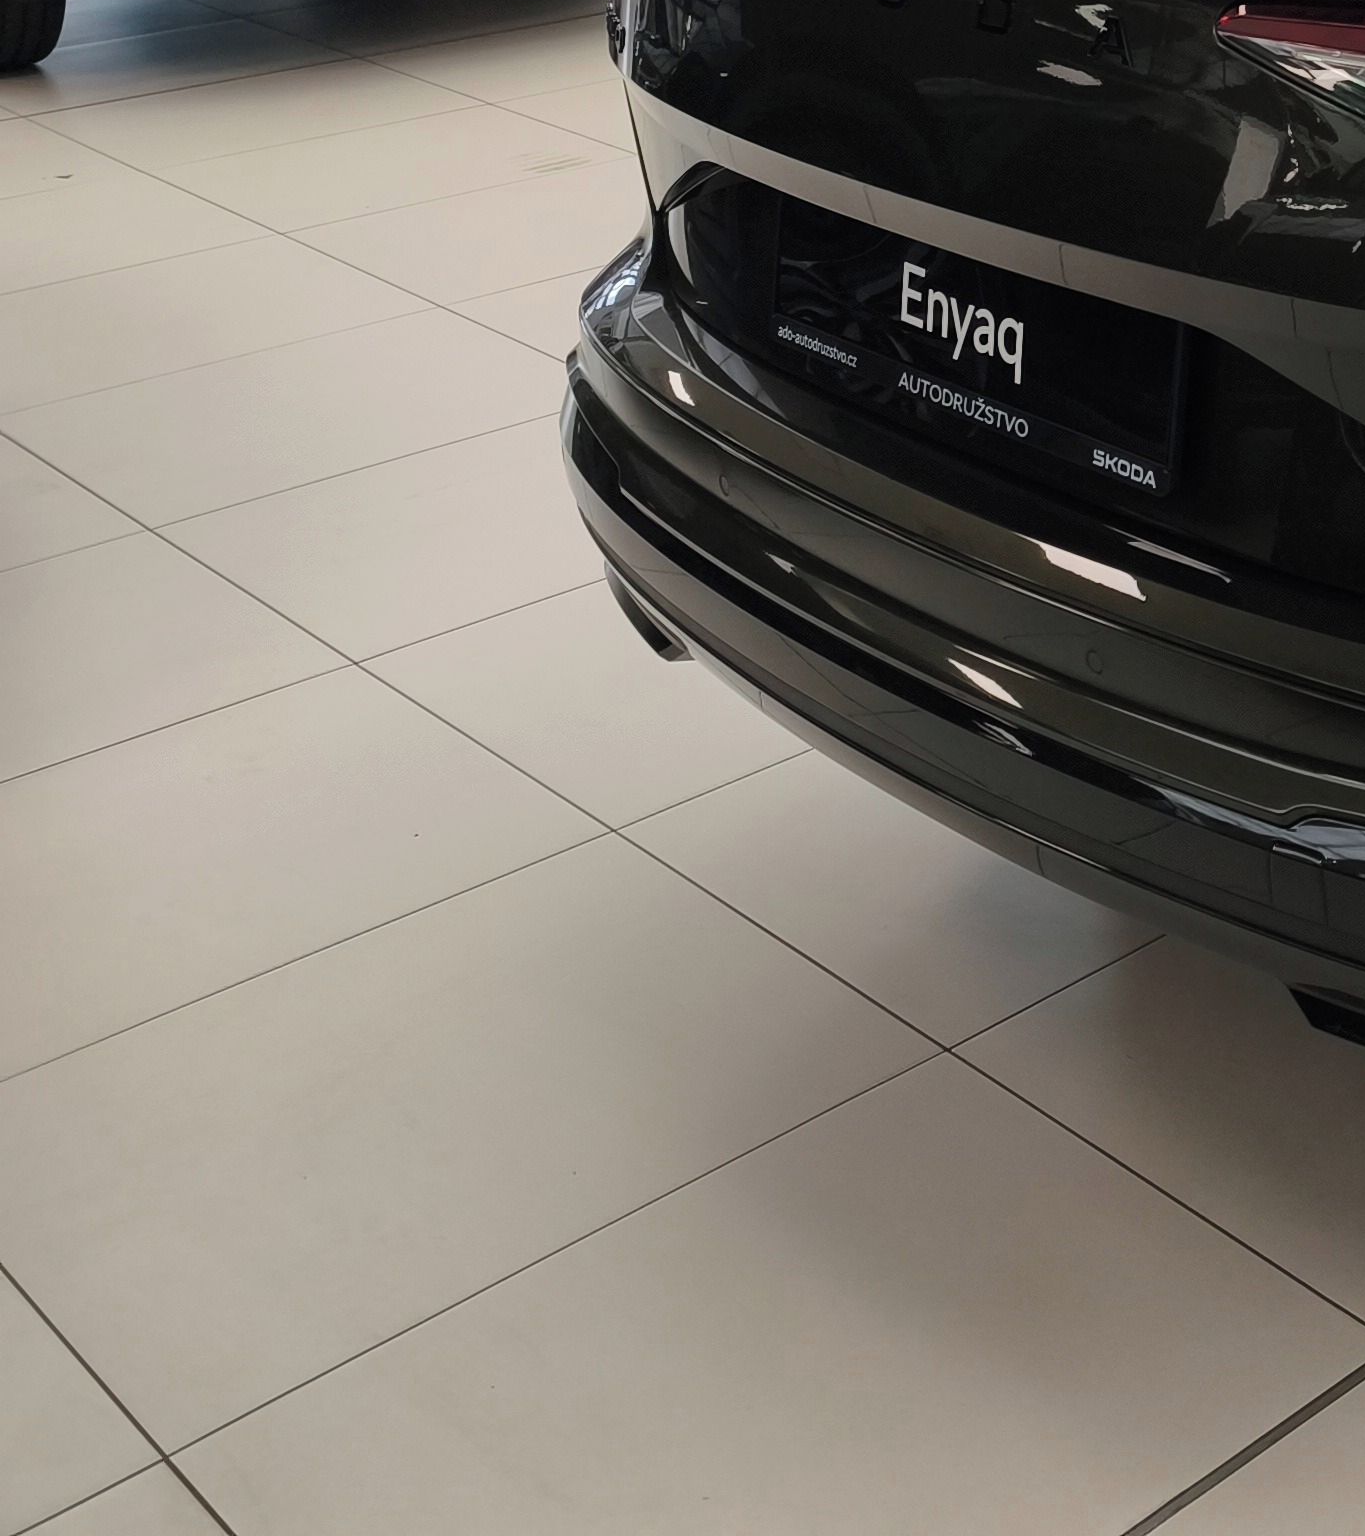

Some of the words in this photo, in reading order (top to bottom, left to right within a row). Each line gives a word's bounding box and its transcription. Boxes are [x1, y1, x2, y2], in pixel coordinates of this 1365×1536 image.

[777, 324, 858, 368] ado-autodruzstvo.cz
[898, 371, 1029, 438] AUTODRUŽSTVO
[900, 261, 1025, 385] Enyaq
